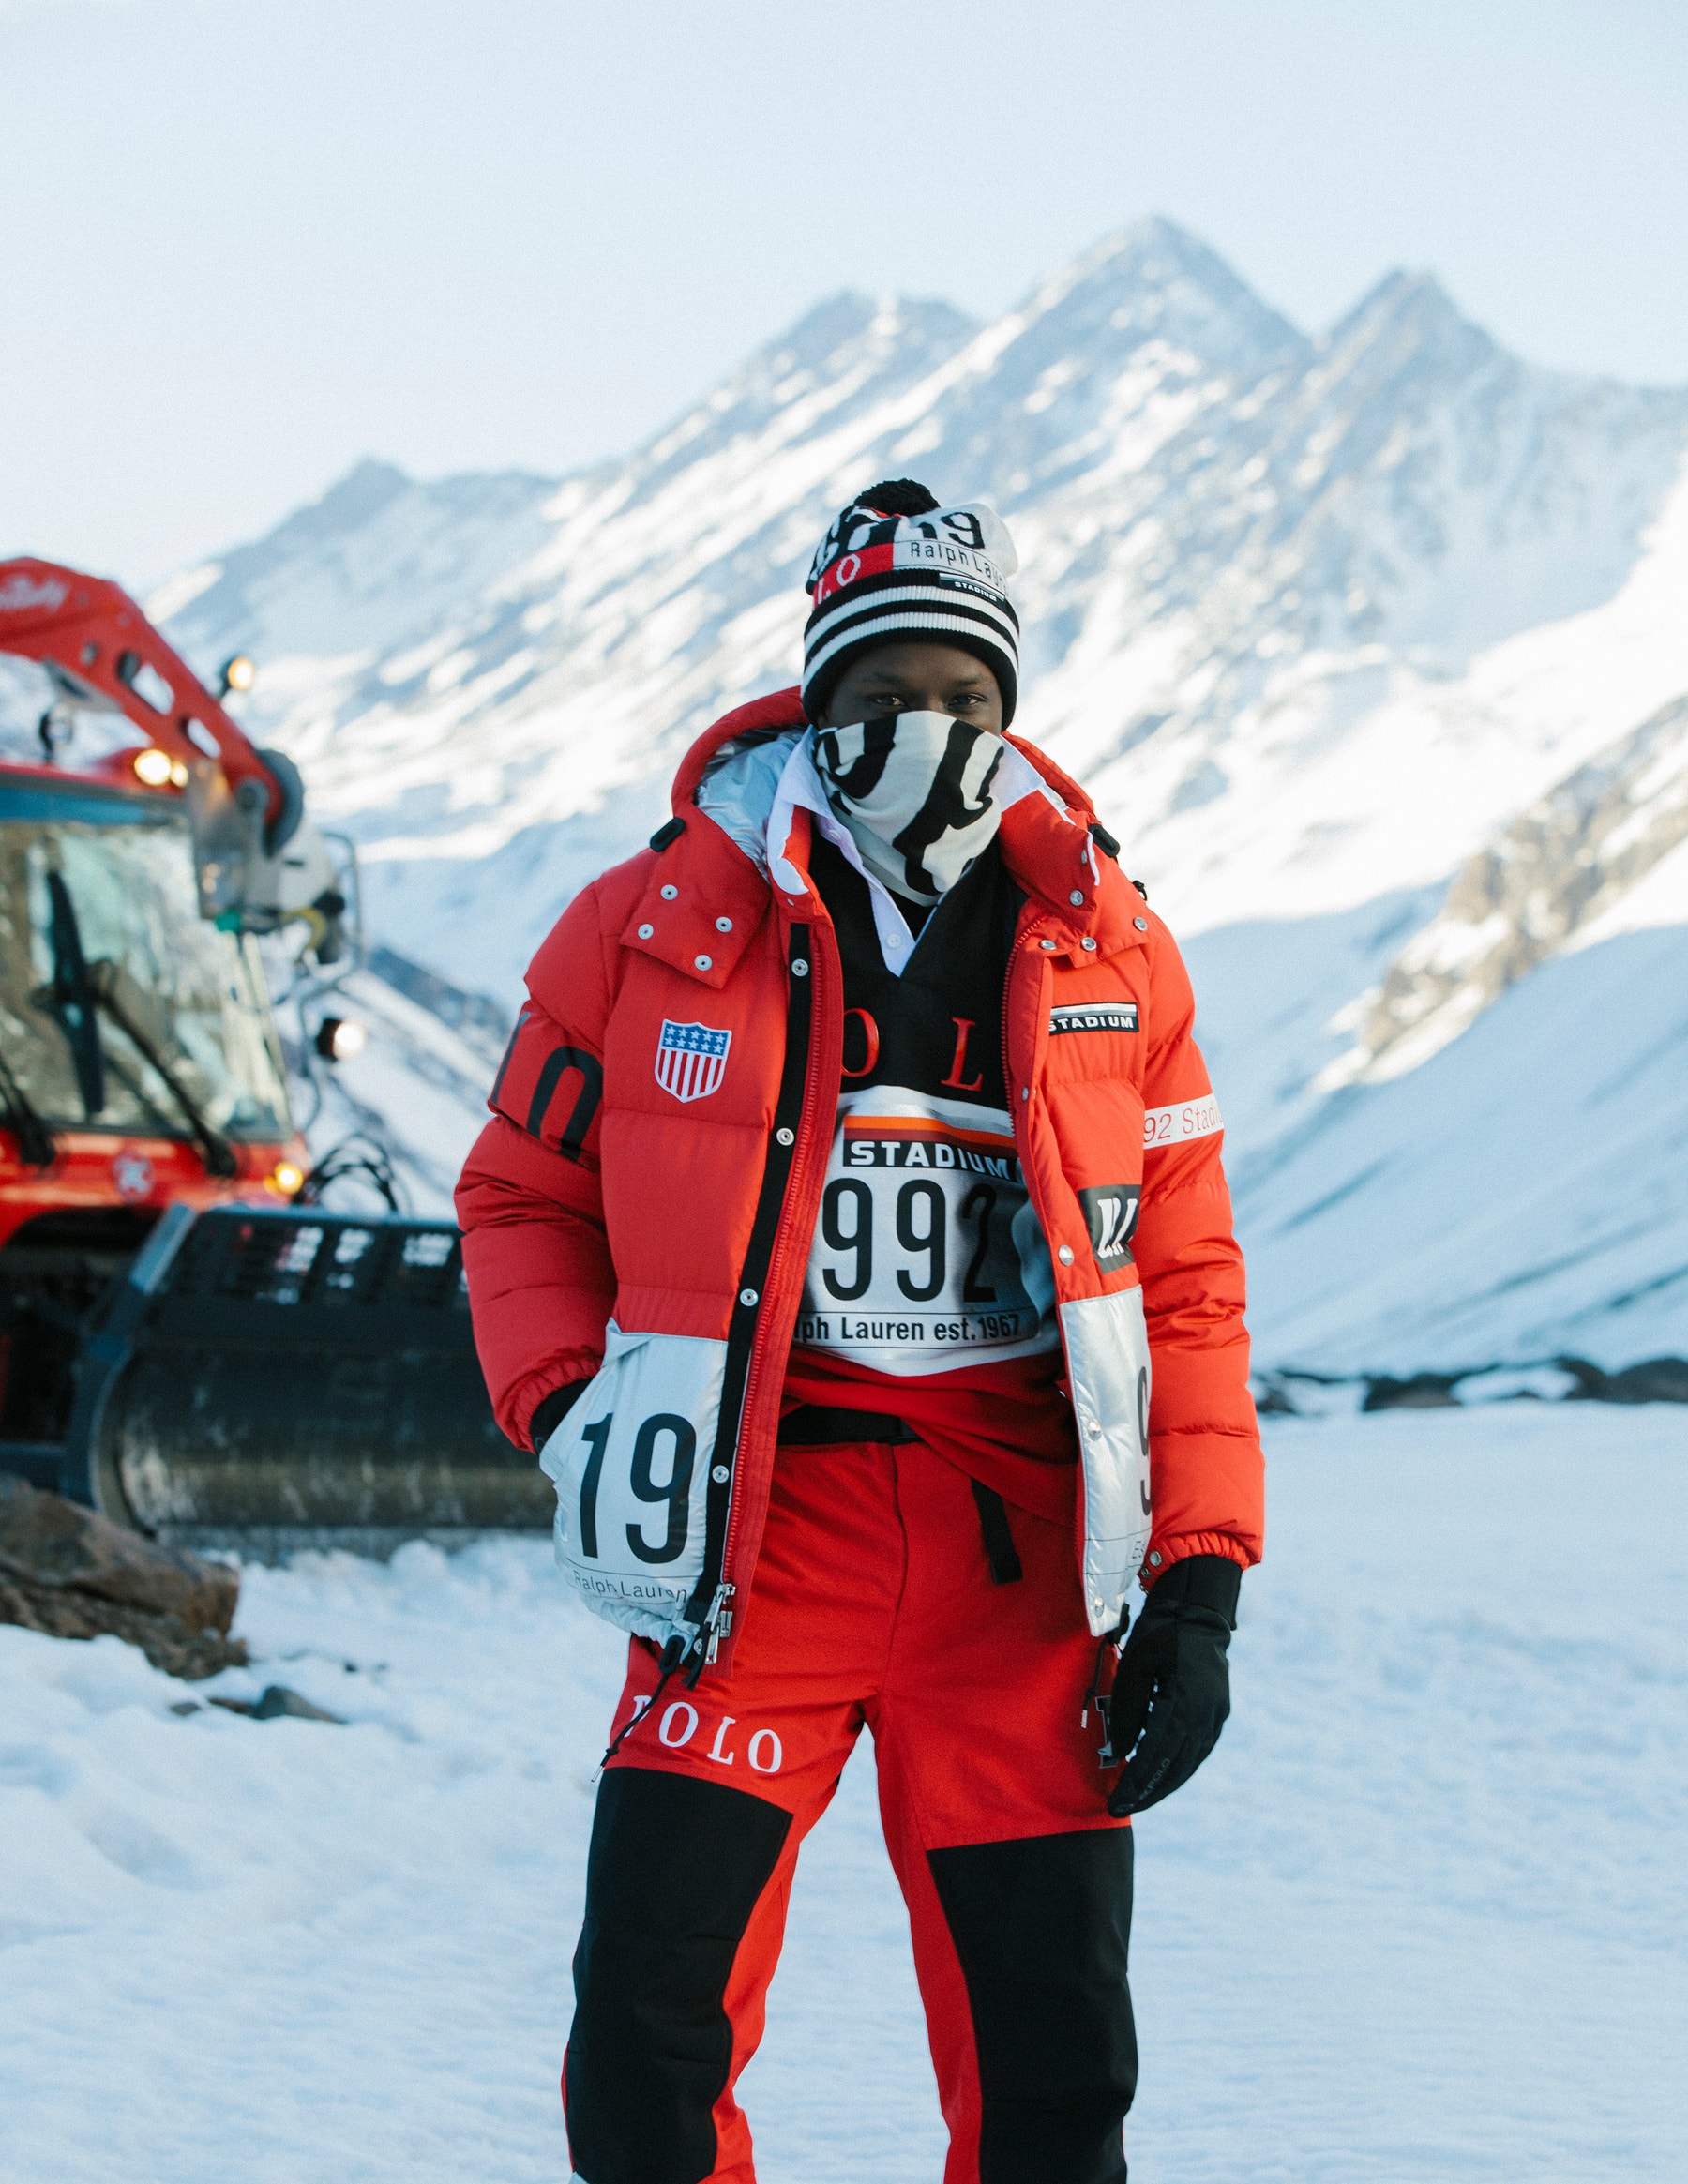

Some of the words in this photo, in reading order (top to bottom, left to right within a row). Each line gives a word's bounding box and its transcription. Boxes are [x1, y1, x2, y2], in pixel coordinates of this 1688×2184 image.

[911, 541, 970, 566] Ralph
[954, 581, 998, 602] STADIUM
[1048, 1015, 1136, 1032] STADIUM
[850, 1140, 1013, 1182] STADIUM
[821, 1177, 998, 1303] 992
[841, 1316, 925, 1342] Lauren
[580, 1411, 697, 1565] 19
[573, 1569, 618, 1596] Ralph
